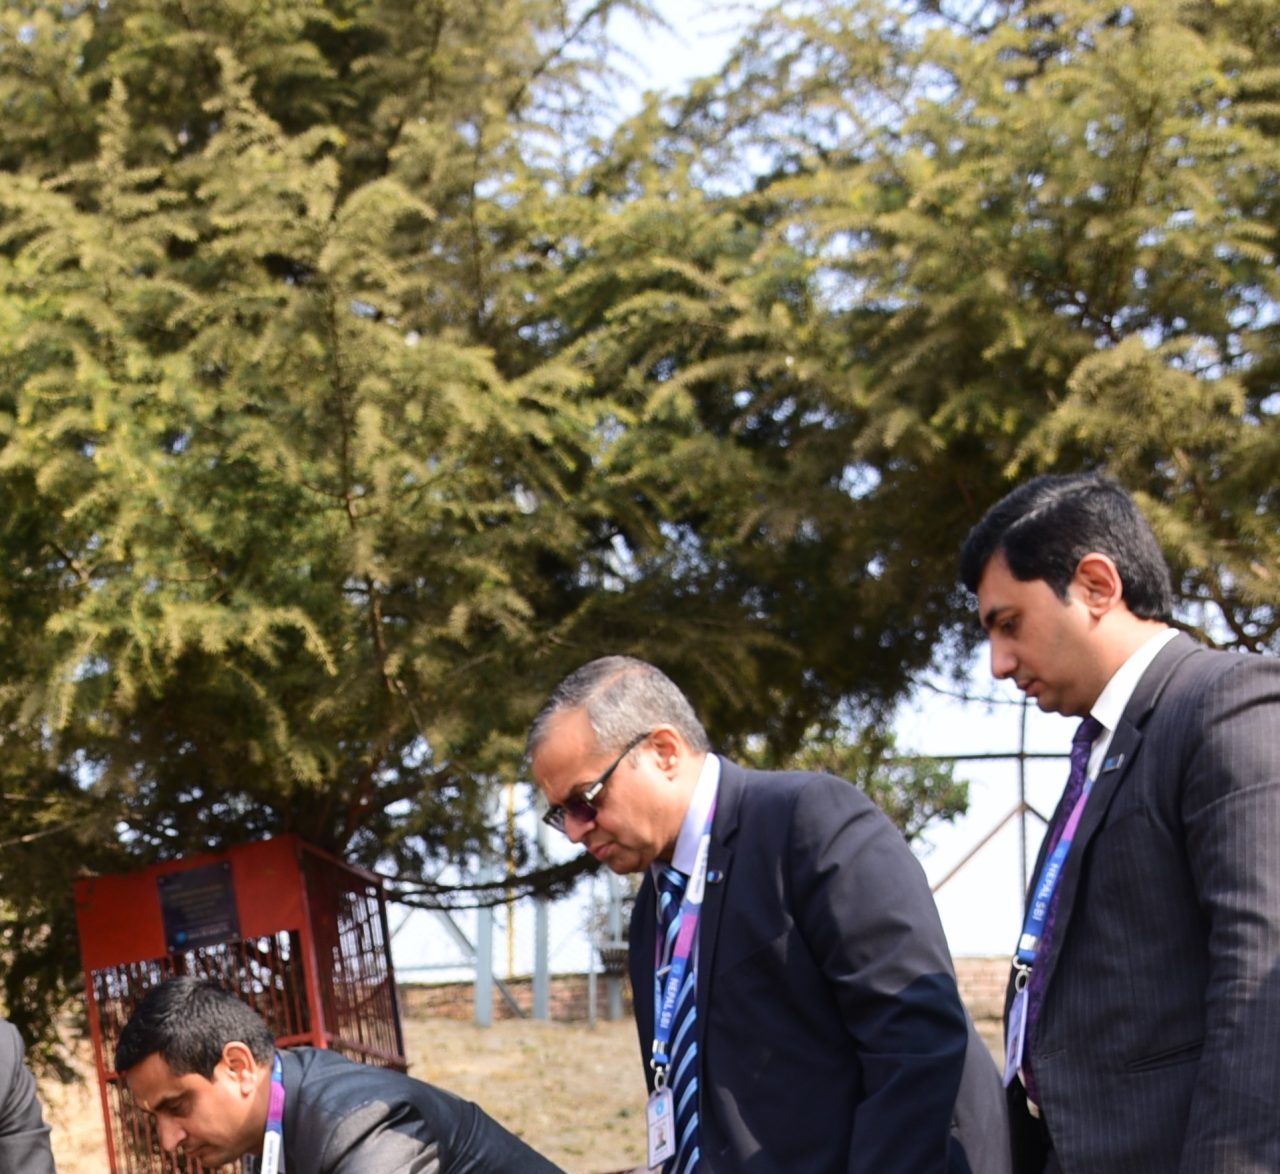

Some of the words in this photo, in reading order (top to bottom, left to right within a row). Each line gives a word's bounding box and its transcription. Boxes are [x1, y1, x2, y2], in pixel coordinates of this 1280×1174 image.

[1037, 863, 1060, 900] NEPAL
[1032, 901, 1047, 922] SBI
[663, 977, 679, 1010] NEPAL
[659, 1011, 672, 1029] SBI
